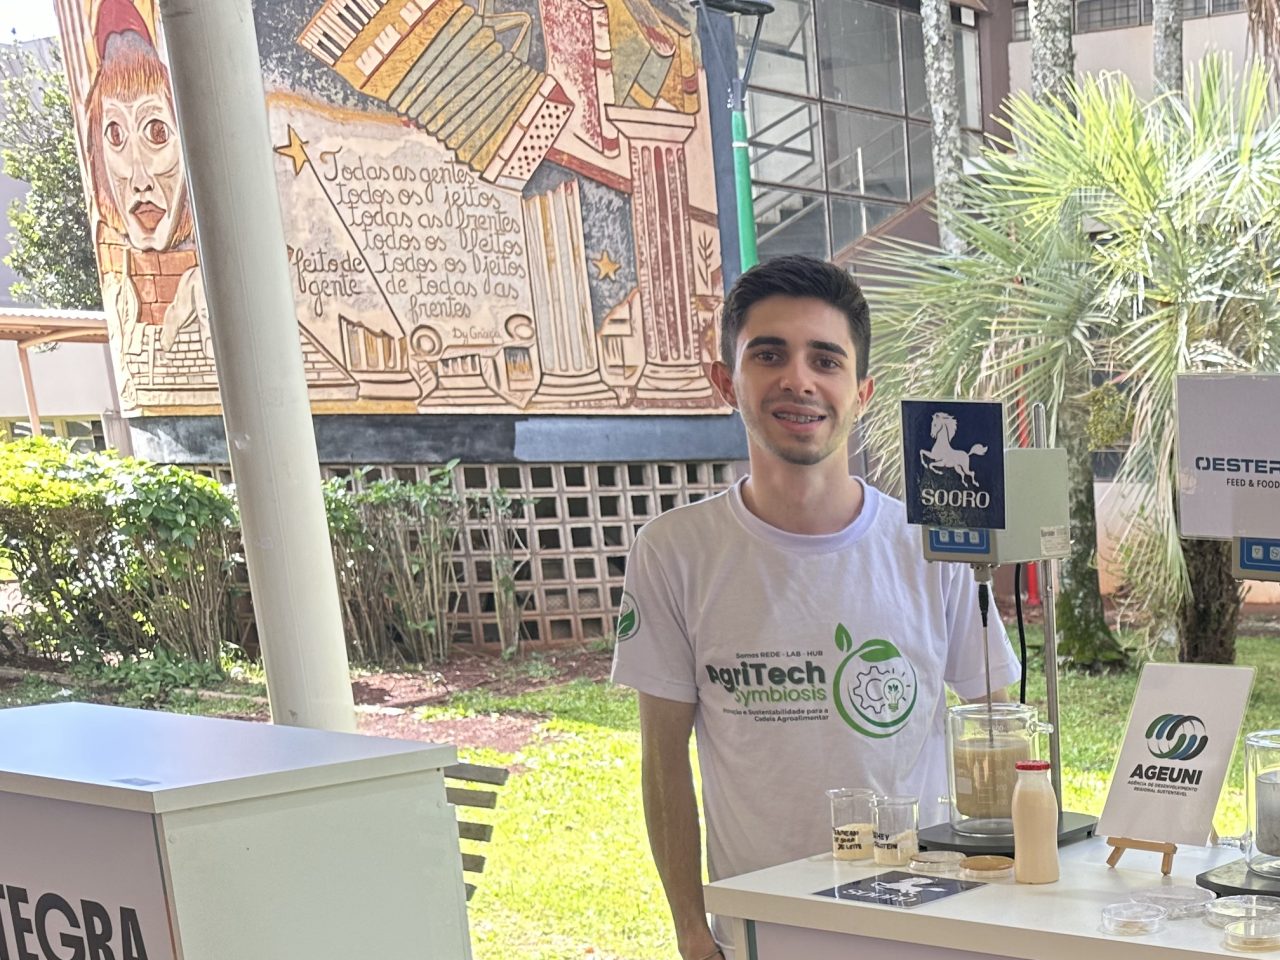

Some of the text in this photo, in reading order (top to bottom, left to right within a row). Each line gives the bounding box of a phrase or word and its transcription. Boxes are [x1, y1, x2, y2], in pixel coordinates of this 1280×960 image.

[320, 146, 475, 203] Todas as gentes
[337, 181, 501, 226] todos os jeitos
[349, 205, 521, 249] todas as frentes
[293, 249, 365, 293] feito de
[363, 228, 523, 273] todos os feitos
[375, 252, 526, 294] todos os jeitos
[386, 272, 520, 300] de todas as
[309, 273, 361, 317] gente
[409, 295, 471, 324] frentes
[921, 489, 990, 509] SOORO
[1226, 478, 1246, 487] FEED
[1257, 480, 1280, 489] FOOD
[705, 660, 826, 693] AgriTech
[1130, 764, 1203, 785] AGEUNI
